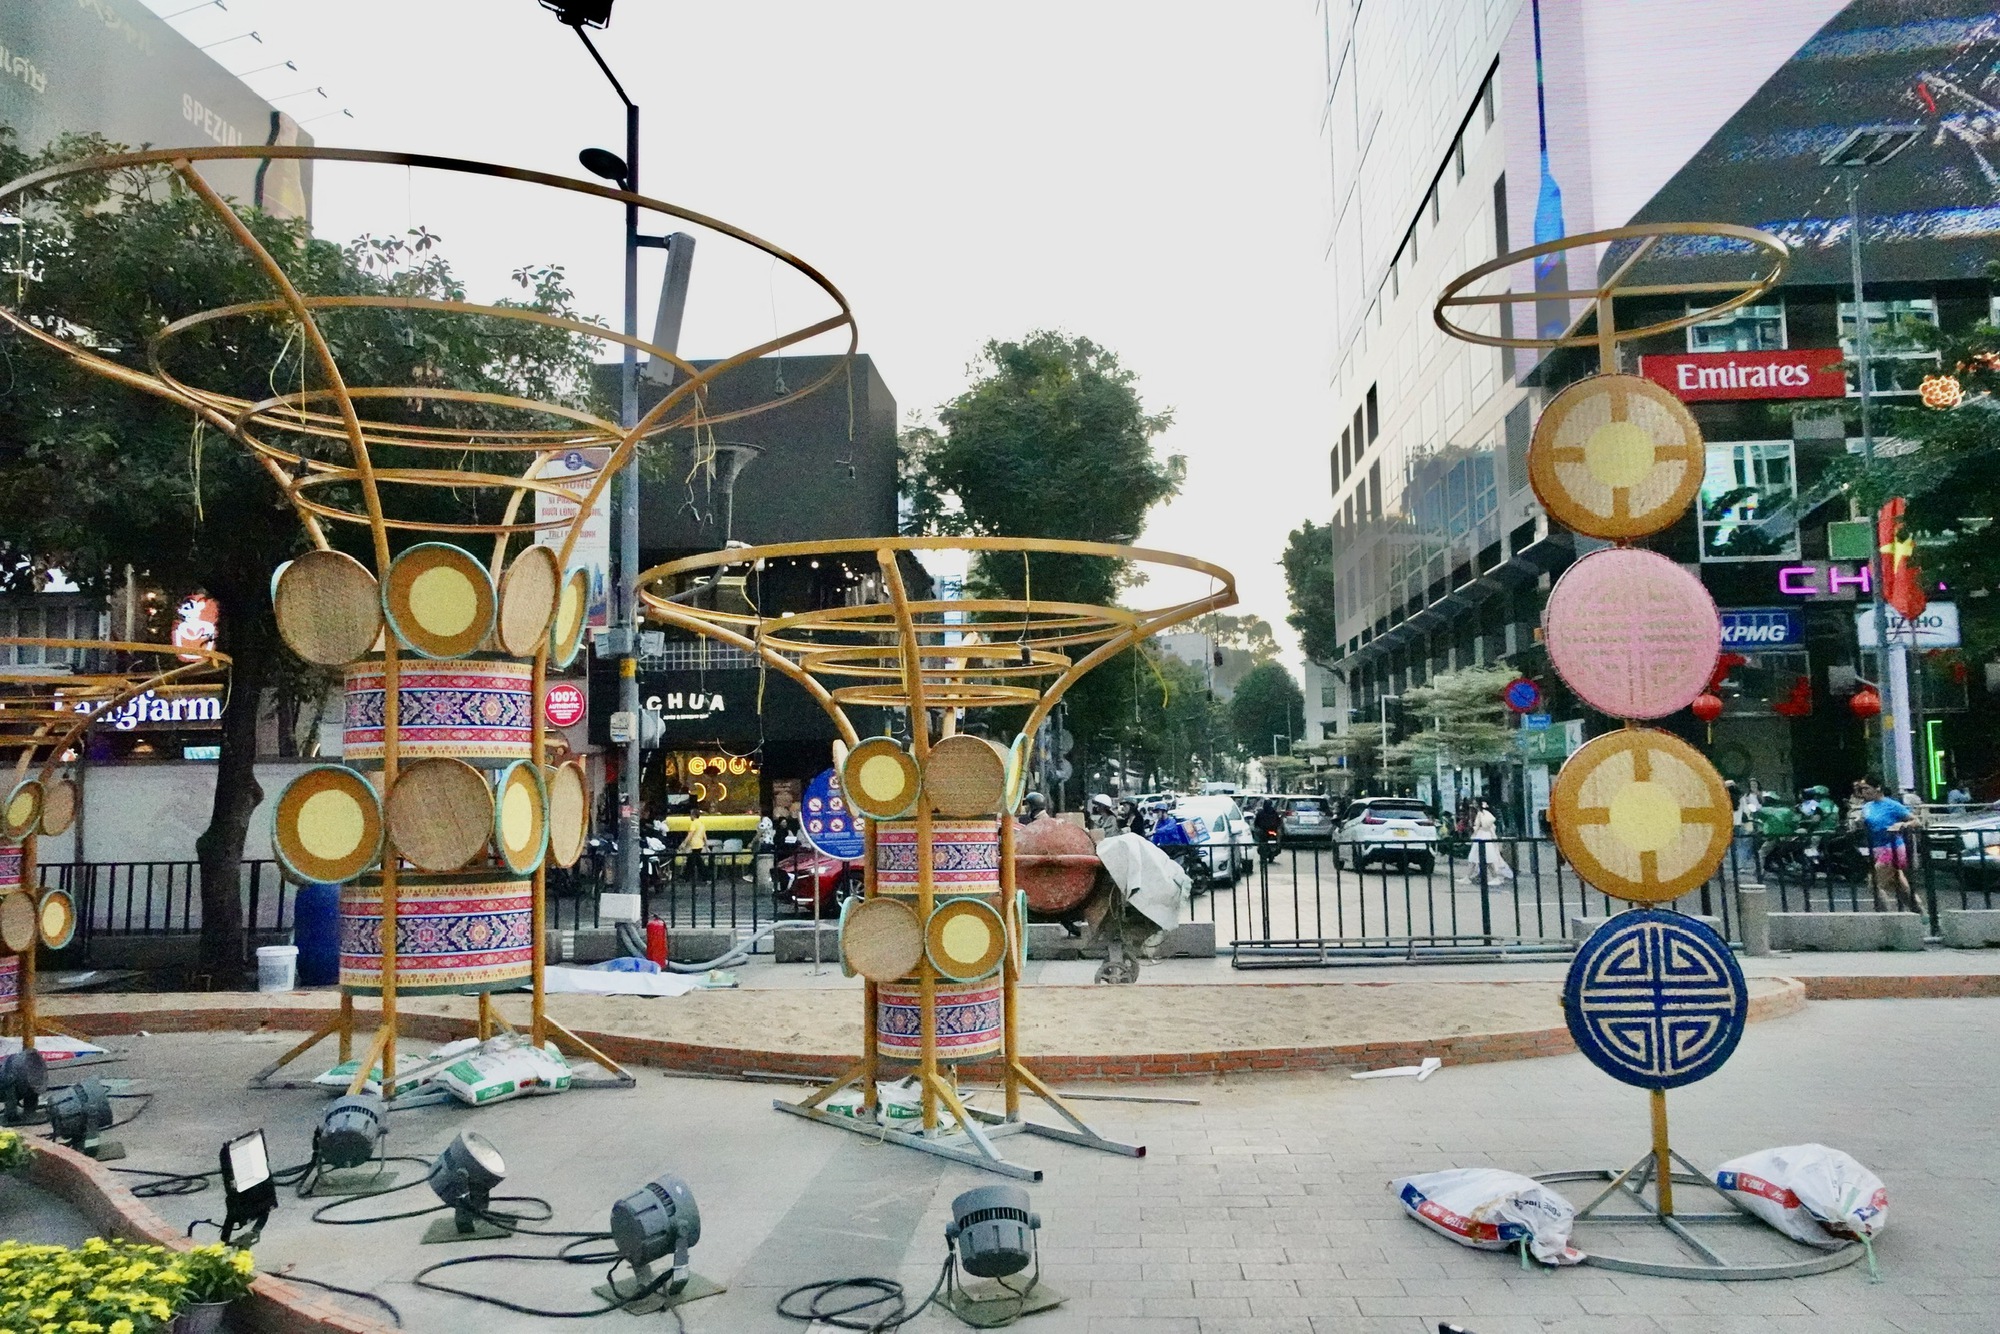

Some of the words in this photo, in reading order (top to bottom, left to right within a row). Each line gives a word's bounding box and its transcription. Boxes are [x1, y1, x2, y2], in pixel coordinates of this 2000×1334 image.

[1676, 363, 1810, 390] Emirates
[1720, 625, 1786, 642] KPMG
[550, 691, 578, 703] 100%
[646, 692, 725, 711] CHUA
